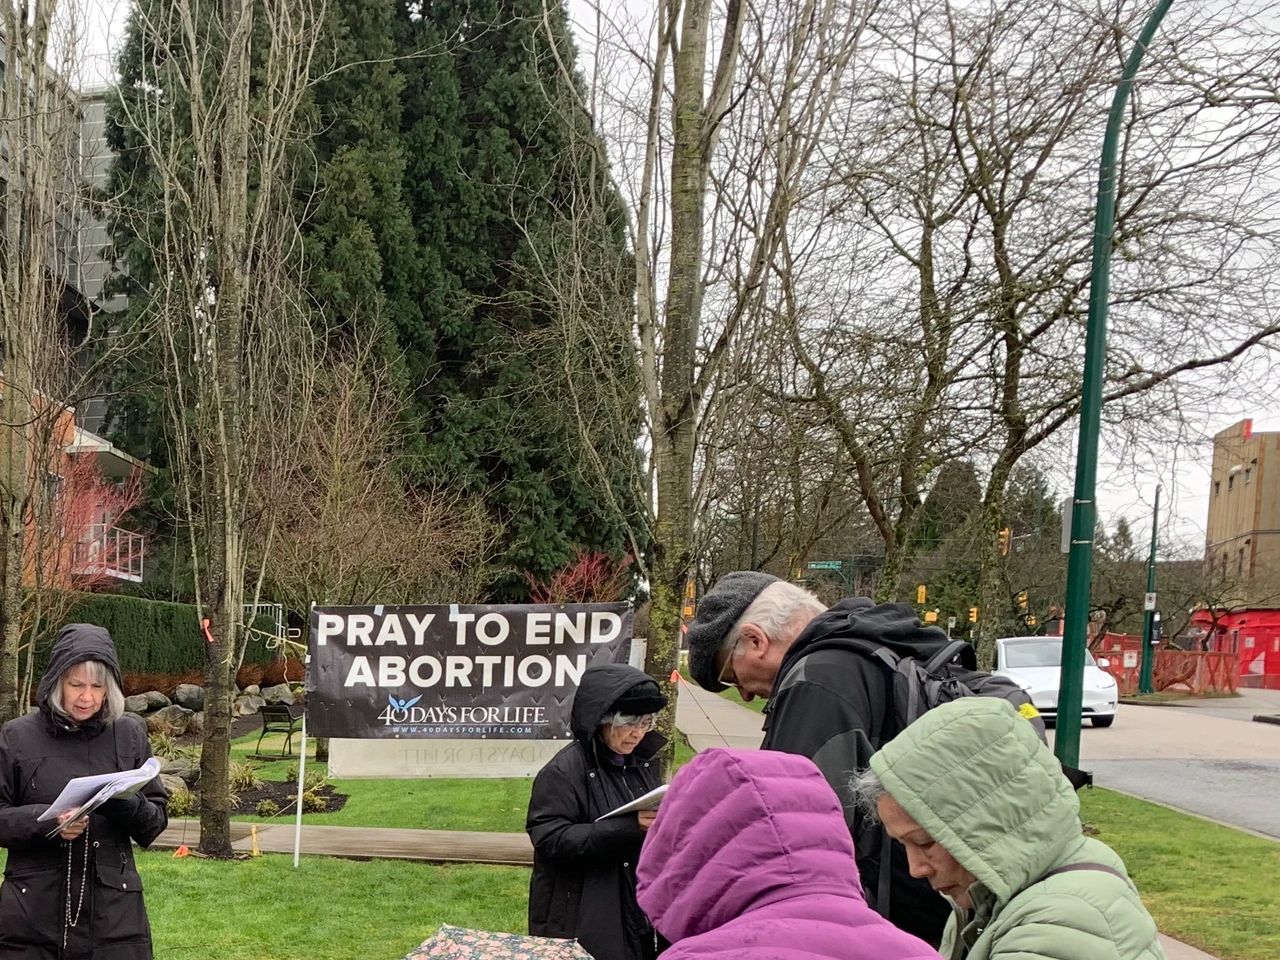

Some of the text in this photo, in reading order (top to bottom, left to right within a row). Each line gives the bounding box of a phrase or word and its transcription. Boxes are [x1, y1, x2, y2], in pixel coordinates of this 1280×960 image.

[318, 611, 622, 646] PRAY TO END
[344, 654, 587, 688] ABORTION
